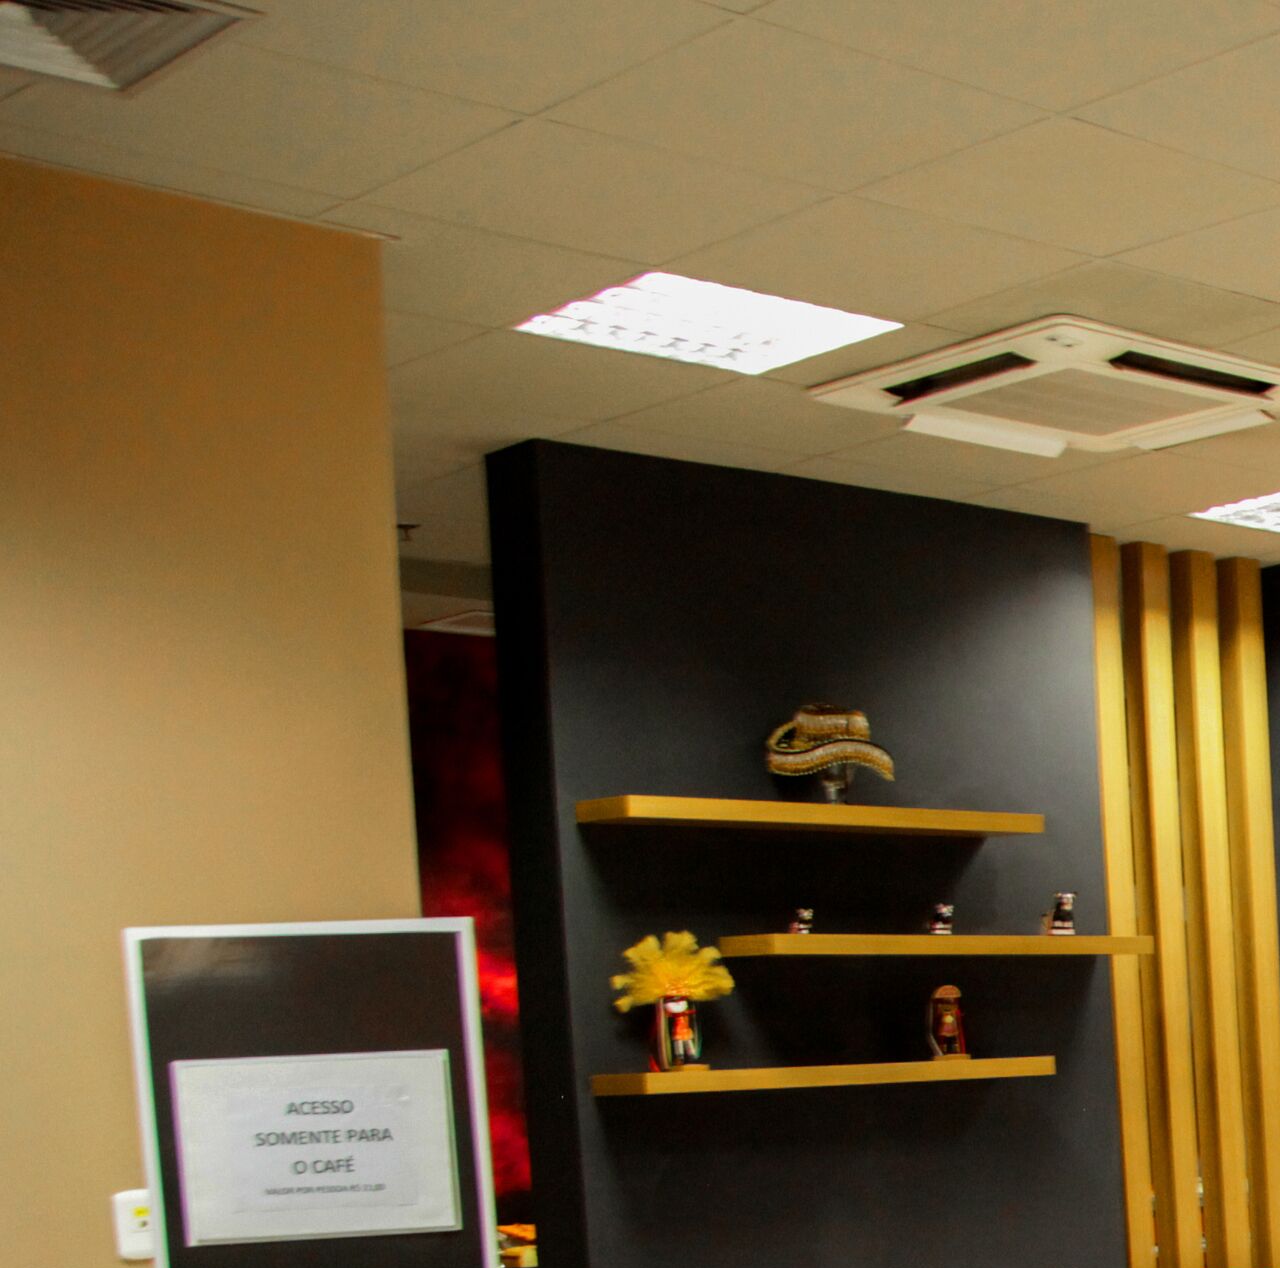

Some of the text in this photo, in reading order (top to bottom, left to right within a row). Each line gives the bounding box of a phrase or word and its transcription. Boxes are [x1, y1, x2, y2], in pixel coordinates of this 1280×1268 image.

[285, 1100, 354, 1115] ACESSO
[255, 1128, 393, 1147] SOMENTE PARA
[293, 1155, 355, 1174] O CAFÉ
